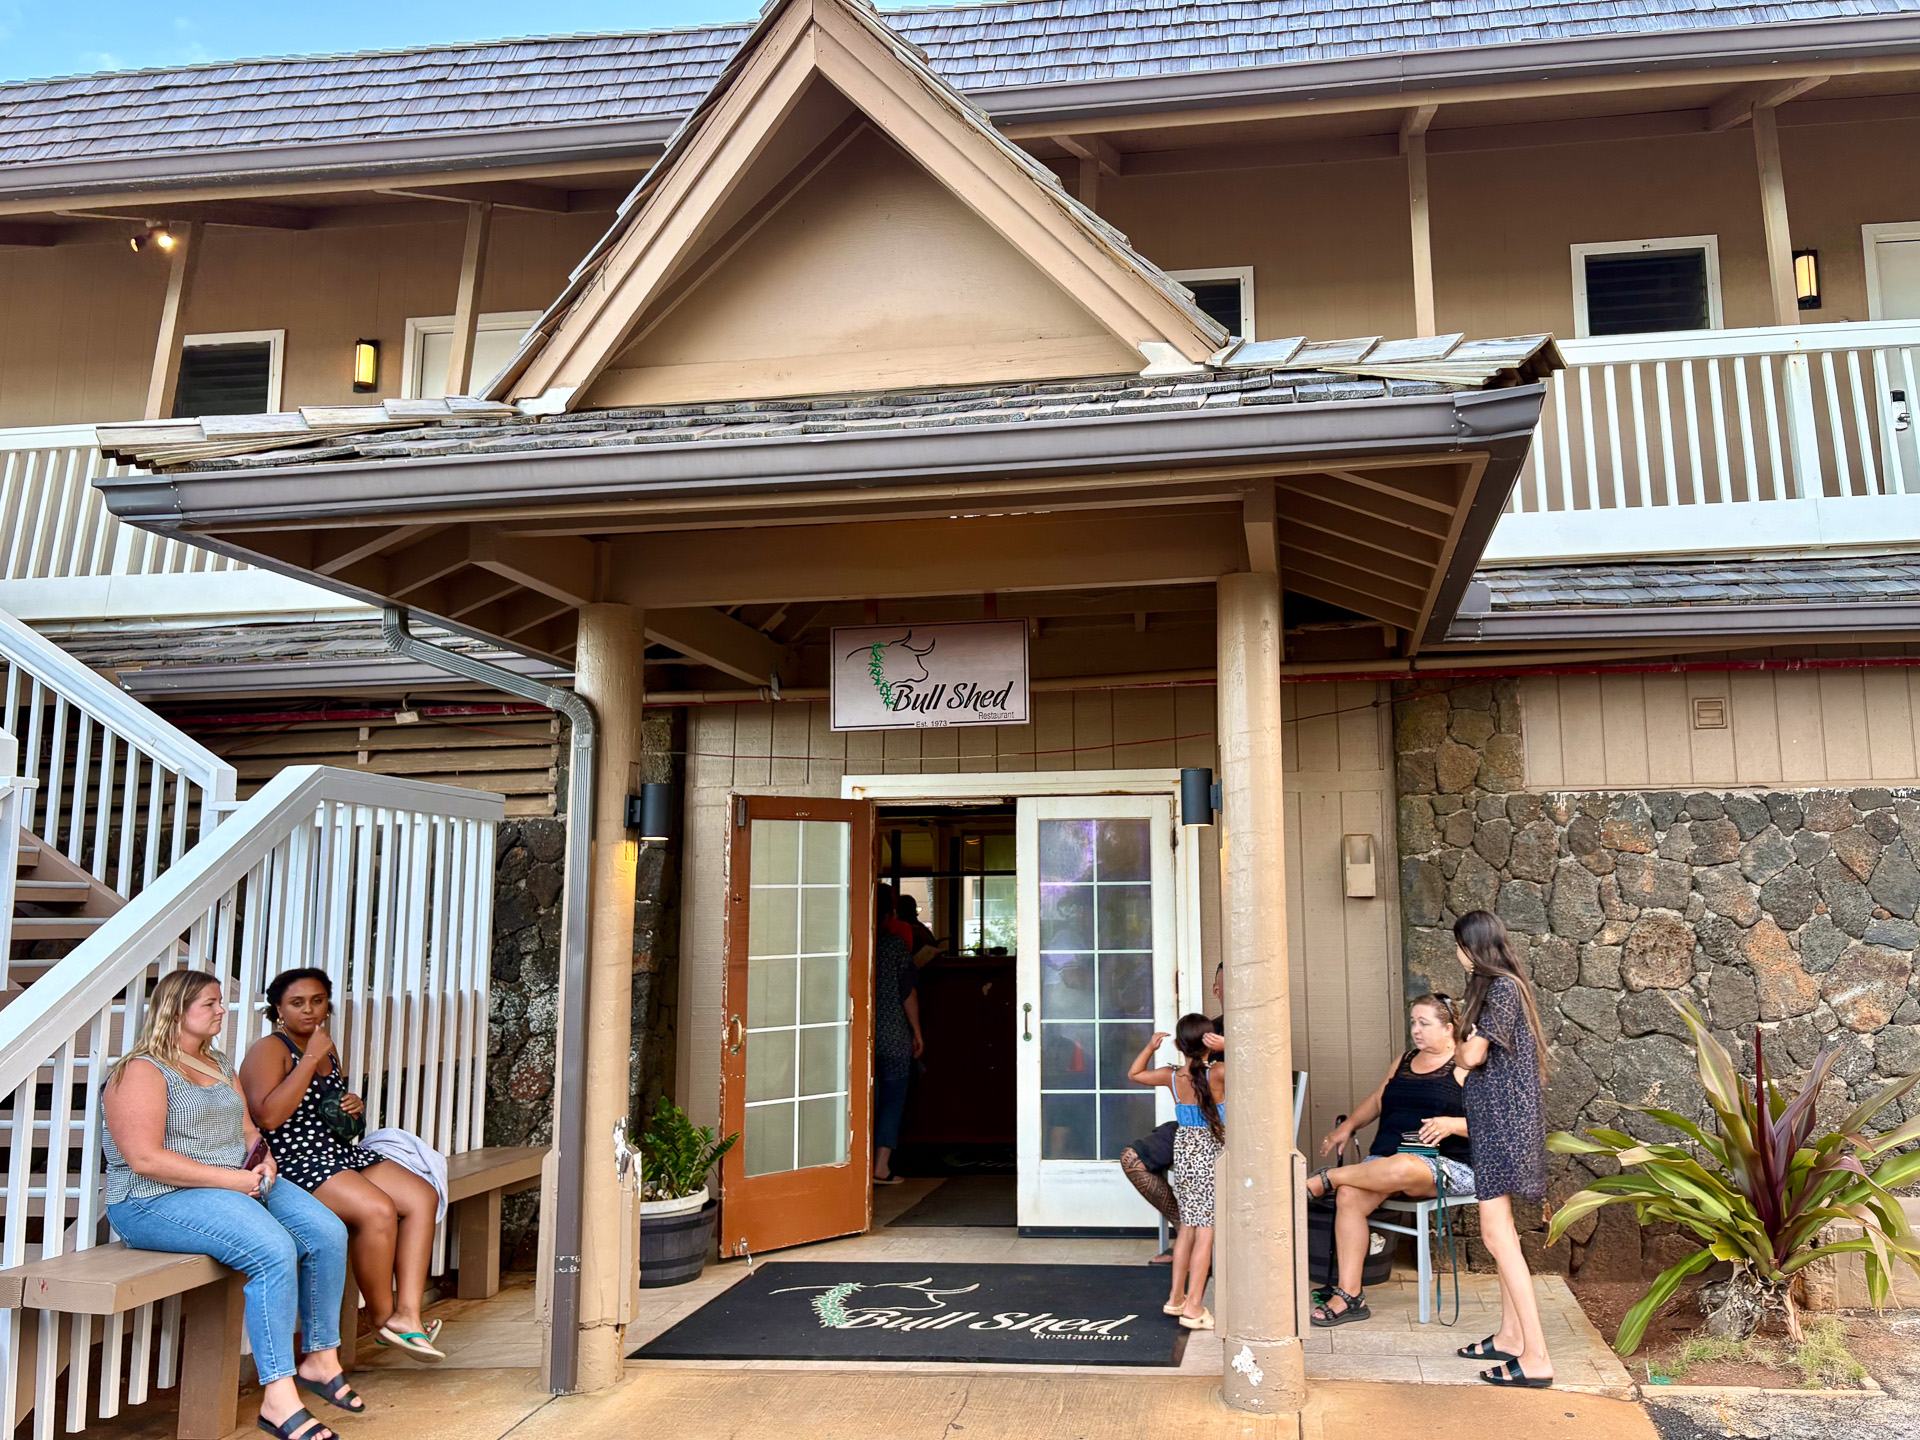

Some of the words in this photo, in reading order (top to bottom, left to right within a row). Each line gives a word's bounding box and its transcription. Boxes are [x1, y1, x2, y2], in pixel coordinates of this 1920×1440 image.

[892, 684, 946, 714] Bull
[946, 681, 1014, 712] Shed
[978, 711, 1015, 720] Restaurant
[836, 1310, 979, 1331] Bull
[968, 1312, 1139, 1335] Shed
[1033, 1333, 1130, 1341] Restaurant
